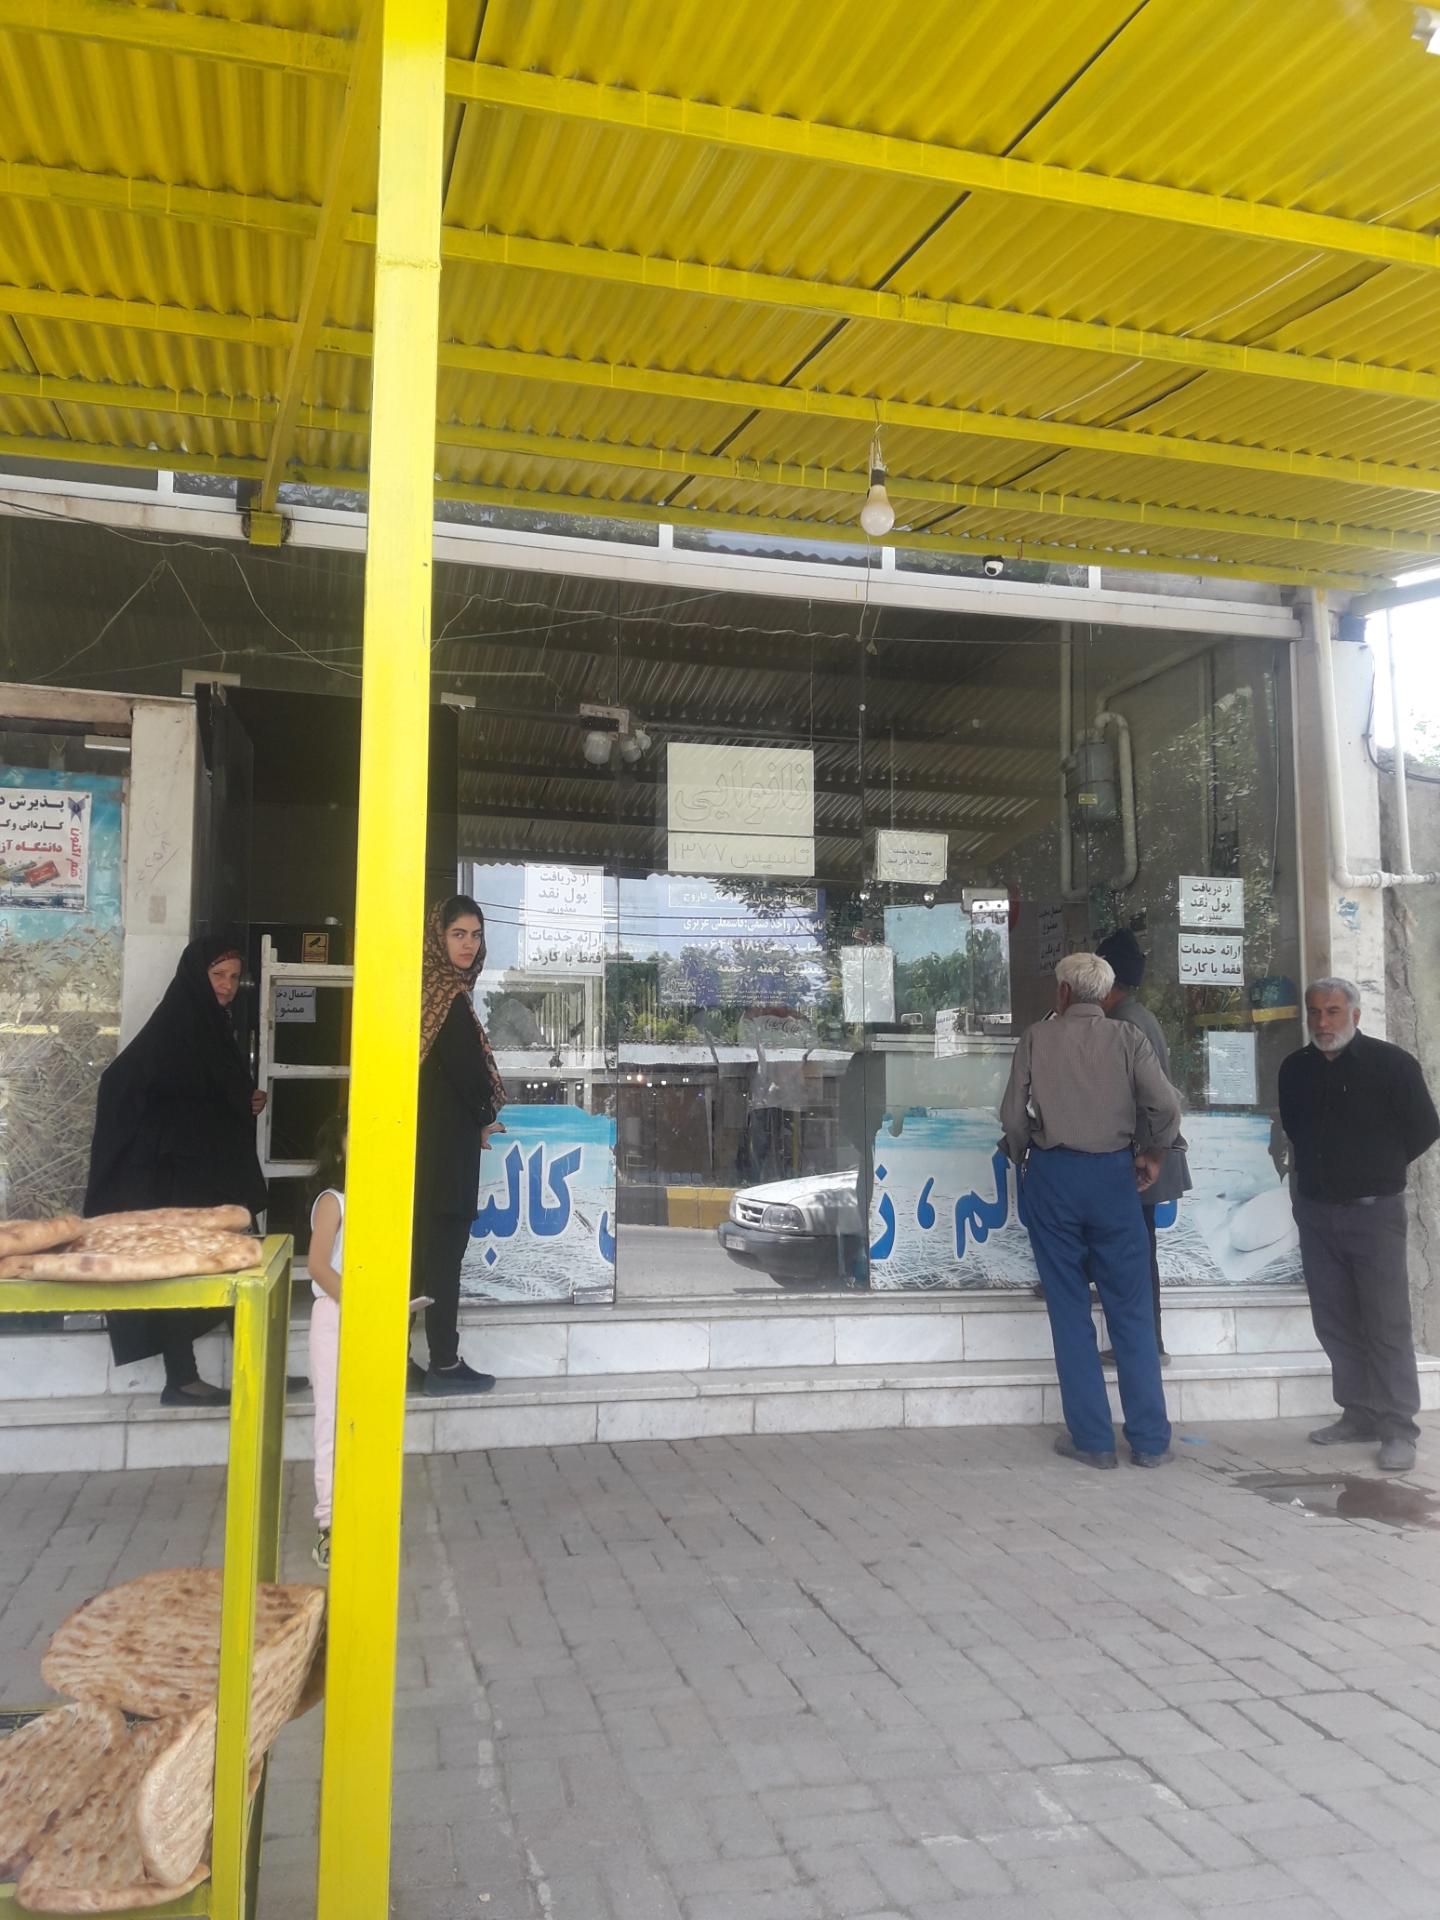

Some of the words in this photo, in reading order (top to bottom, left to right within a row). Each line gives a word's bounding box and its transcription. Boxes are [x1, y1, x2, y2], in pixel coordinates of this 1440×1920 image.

[8, 795, 65, 813] پذیرش
[19, 820, 65, 833] کاردانی
[15, 839, 63, 854] دانشگاه
[673, 841, 728, 861] ۱۳۷۷
[539, 870, 578, 886] دریافت
[580, 872, 591, 886] از
[537, 888, 561, 900] نقد
[563, 887, 589, 905] پول
[1191, 882, 1224, 897] دریافت
[1225, 884, 1233, 897] از
[1190, 897, 1209, 909] نقد
[1211, 897, 1232, 913] پول
[528, 929, 573, 945] خدمات
[576, 950, 602, 964] فقط
[1180, 944, 1217, 956] خدمات
[528, 950, 562, 966] کارت
[564, 951, 574, 967] با
[1181, 962, 1209, 977] کارت
[1210, 963, 1218, 976] با
[1221, 963, 1242, 975] فقط
[276, 1003, 305, 1018] ممنو
